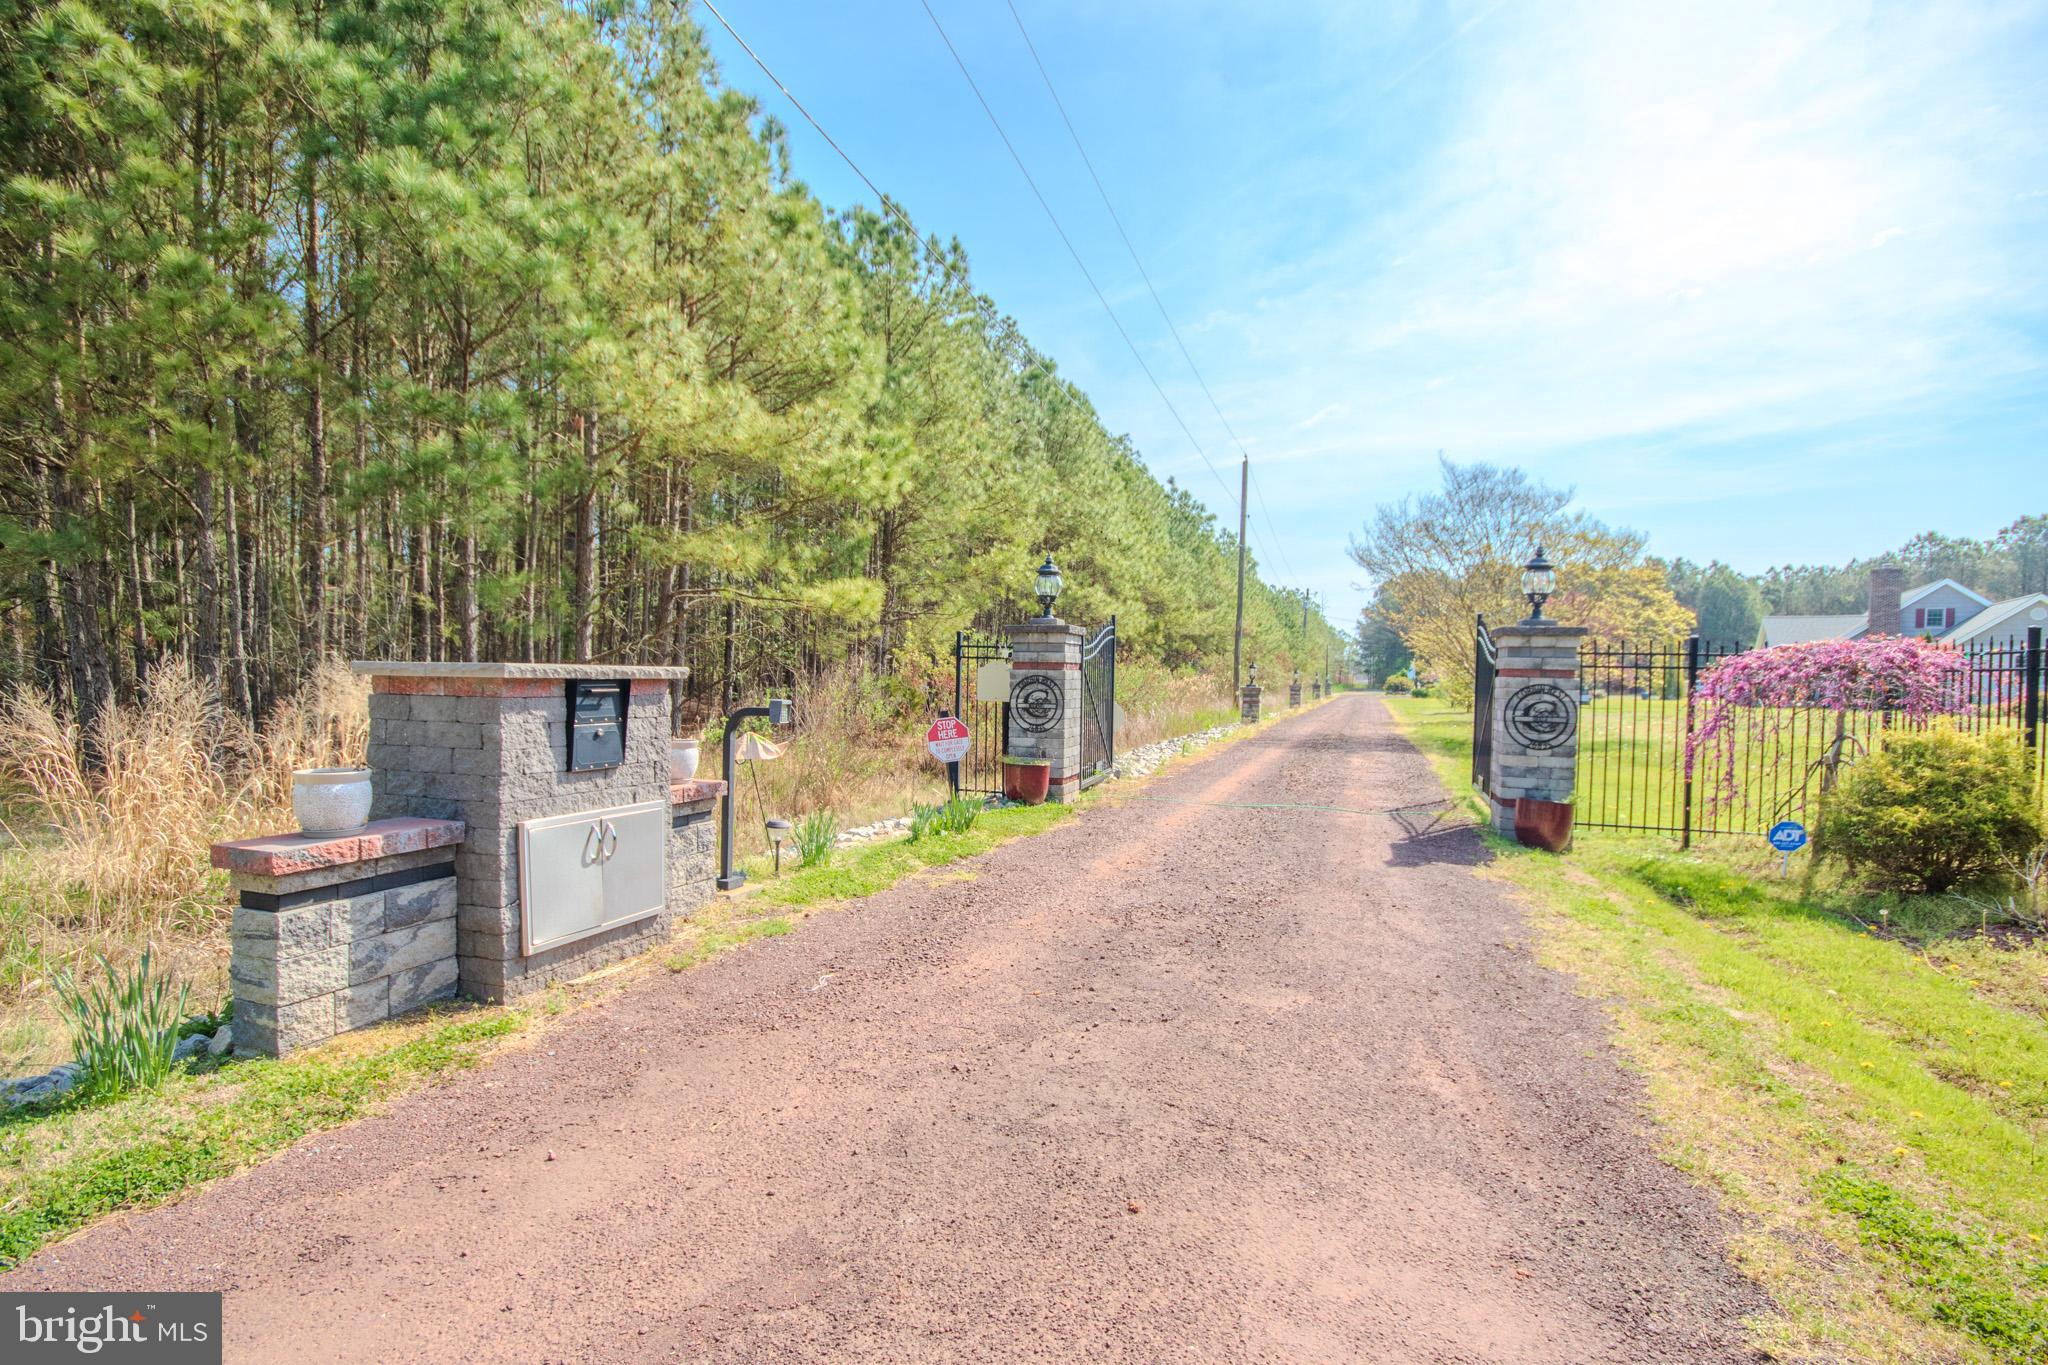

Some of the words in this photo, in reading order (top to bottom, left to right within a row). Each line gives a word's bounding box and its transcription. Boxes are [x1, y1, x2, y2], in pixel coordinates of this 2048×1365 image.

[937, 720, 956, 730] STOP
[938, 729, 958, 740] HERE
[1772, 829, 1804, 841] ADT
